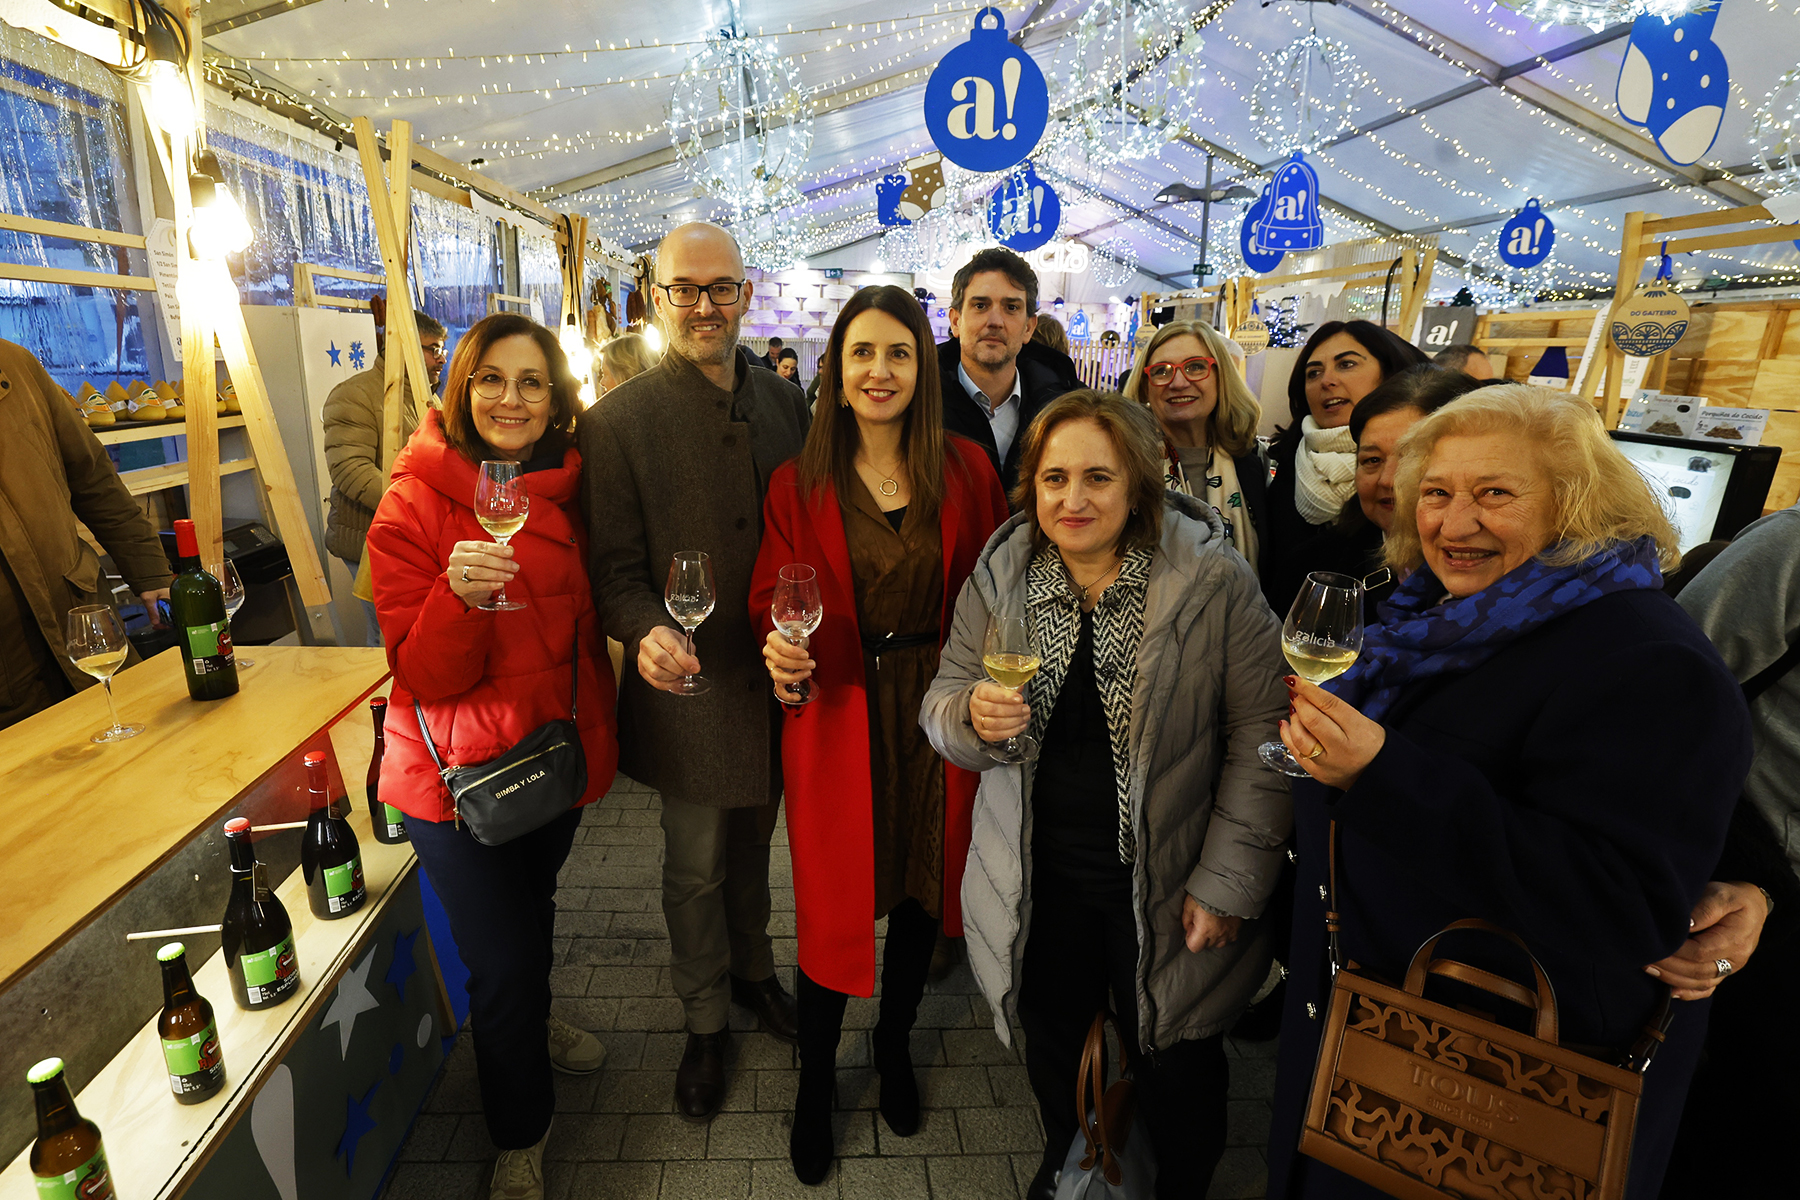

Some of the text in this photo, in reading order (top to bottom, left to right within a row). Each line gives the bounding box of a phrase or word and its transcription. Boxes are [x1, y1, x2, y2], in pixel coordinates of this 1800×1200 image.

[947, 57, 1021, 140] a!
[1001, 185, 1044, 234] a!
[1275, 190, 1307, 220] a!
[1507, 218, 1546, 256] a!
[1426, 320, 1459, 346] a!
[1295, 630, 1336, 648] galicia
[495, 783, 520, 800] BIMBA
[526, 770, 546, 784] LOLA
[1409, 1061, 1520, 1124] TOUS
